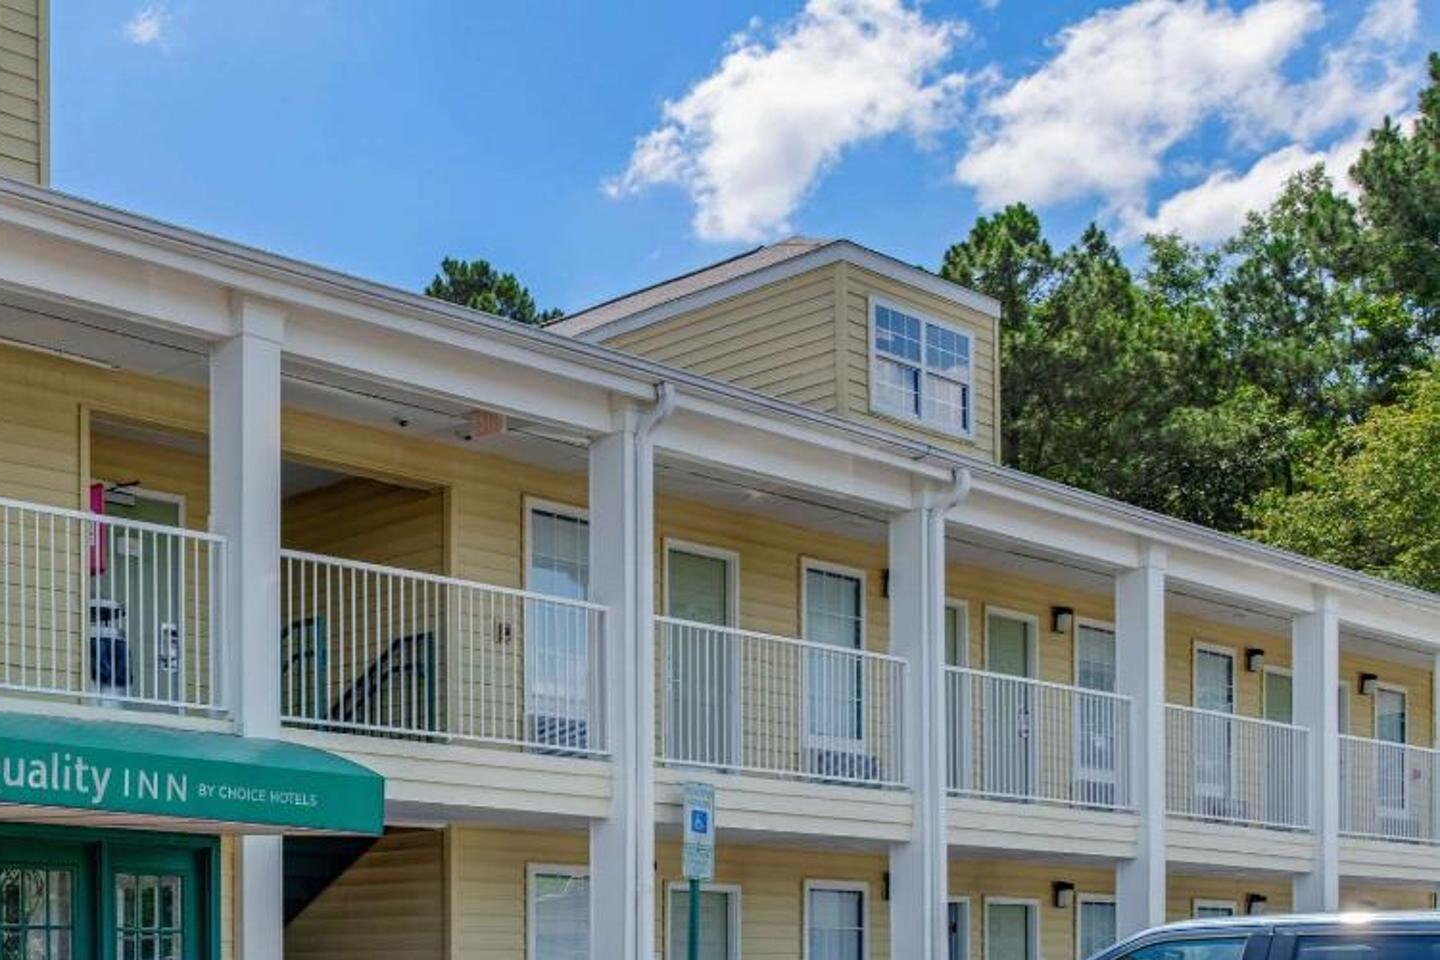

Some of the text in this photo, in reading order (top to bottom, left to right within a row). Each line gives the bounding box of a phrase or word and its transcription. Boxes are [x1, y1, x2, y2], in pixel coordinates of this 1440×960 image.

[123, 768, 188, 802] INN
[198, 783, 216, 797] BY
[218, 785, 267, 802] CHOICE
[269, 789, 319, 807] HOTELS
